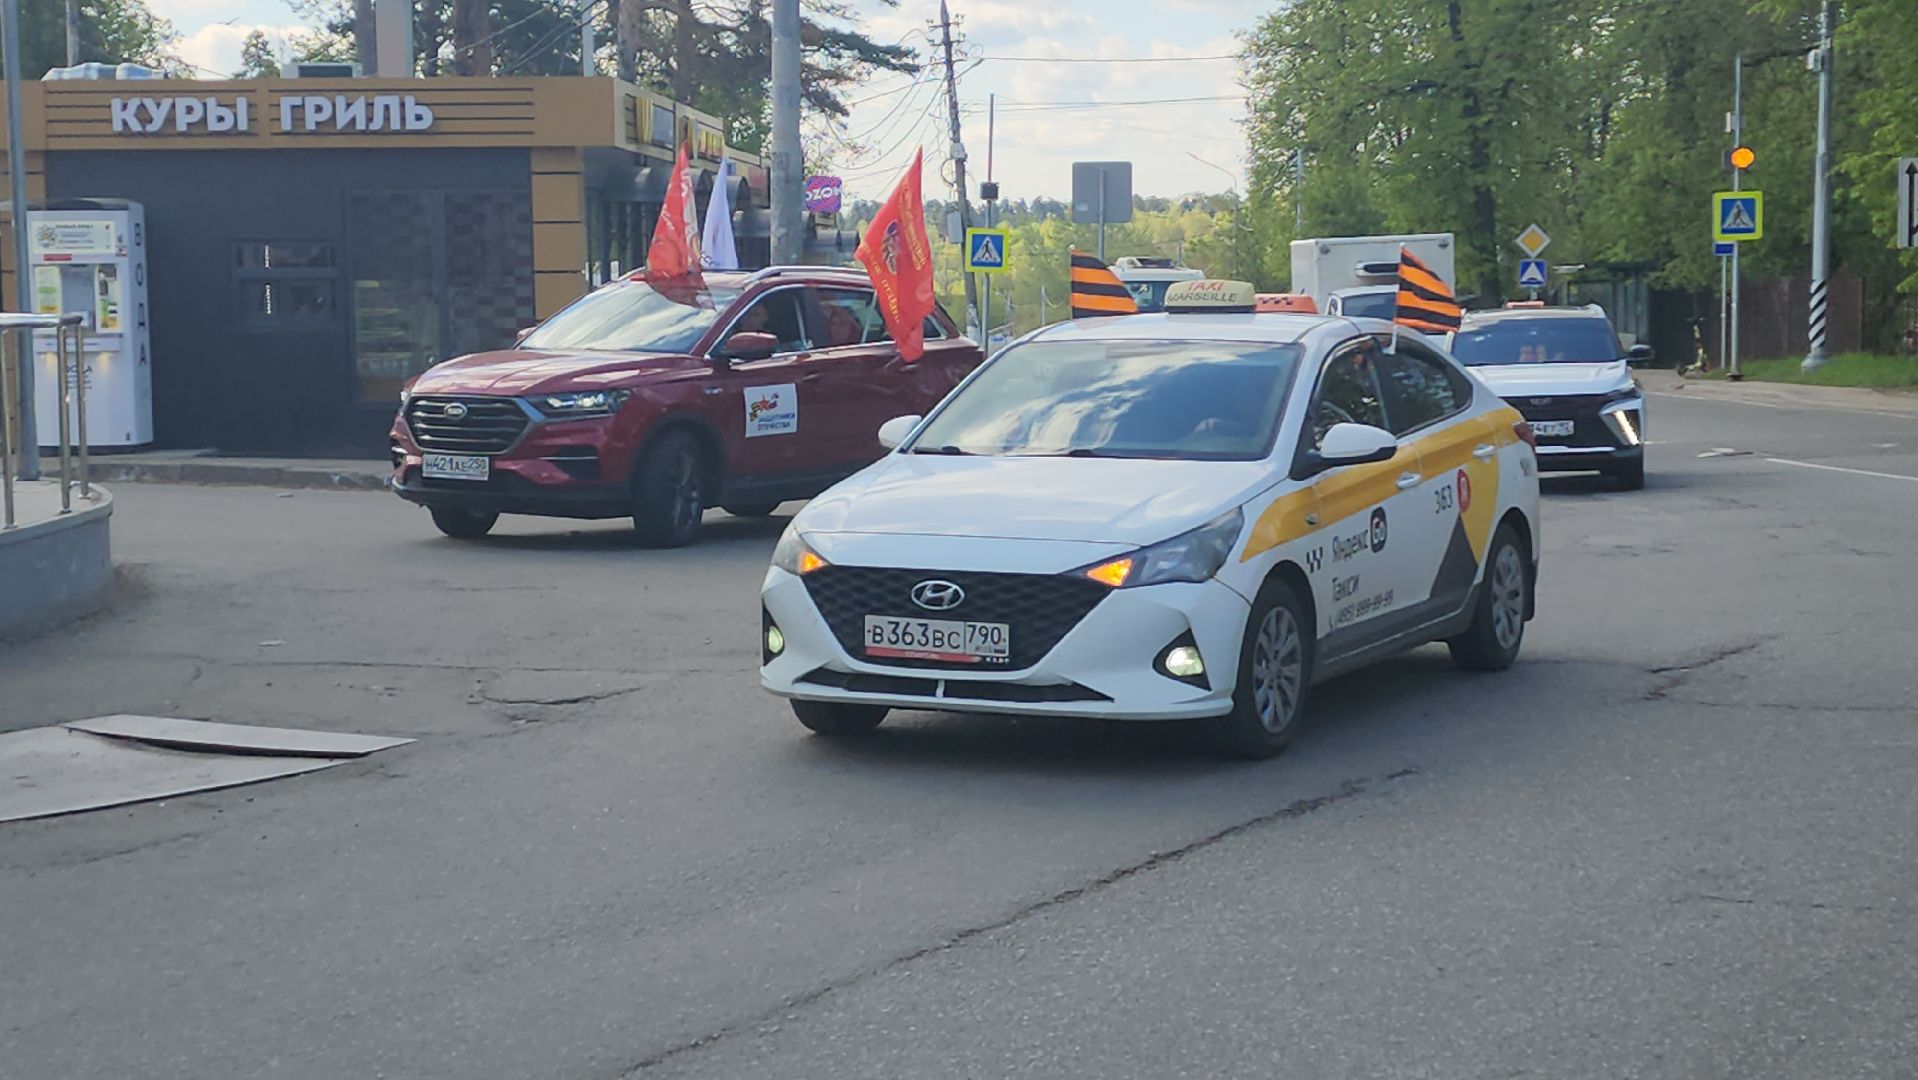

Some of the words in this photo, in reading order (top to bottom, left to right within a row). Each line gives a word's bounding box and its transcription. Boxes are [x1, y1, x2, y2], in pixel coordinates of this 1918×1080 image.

[110, 96, 249, 132] КУРЫ
[279, 95, 434, 131] ГРИЛЬ
[1187, 281, 1225, 291] TAXI
[1167, 292, 1238, 303] MARSEILLE
